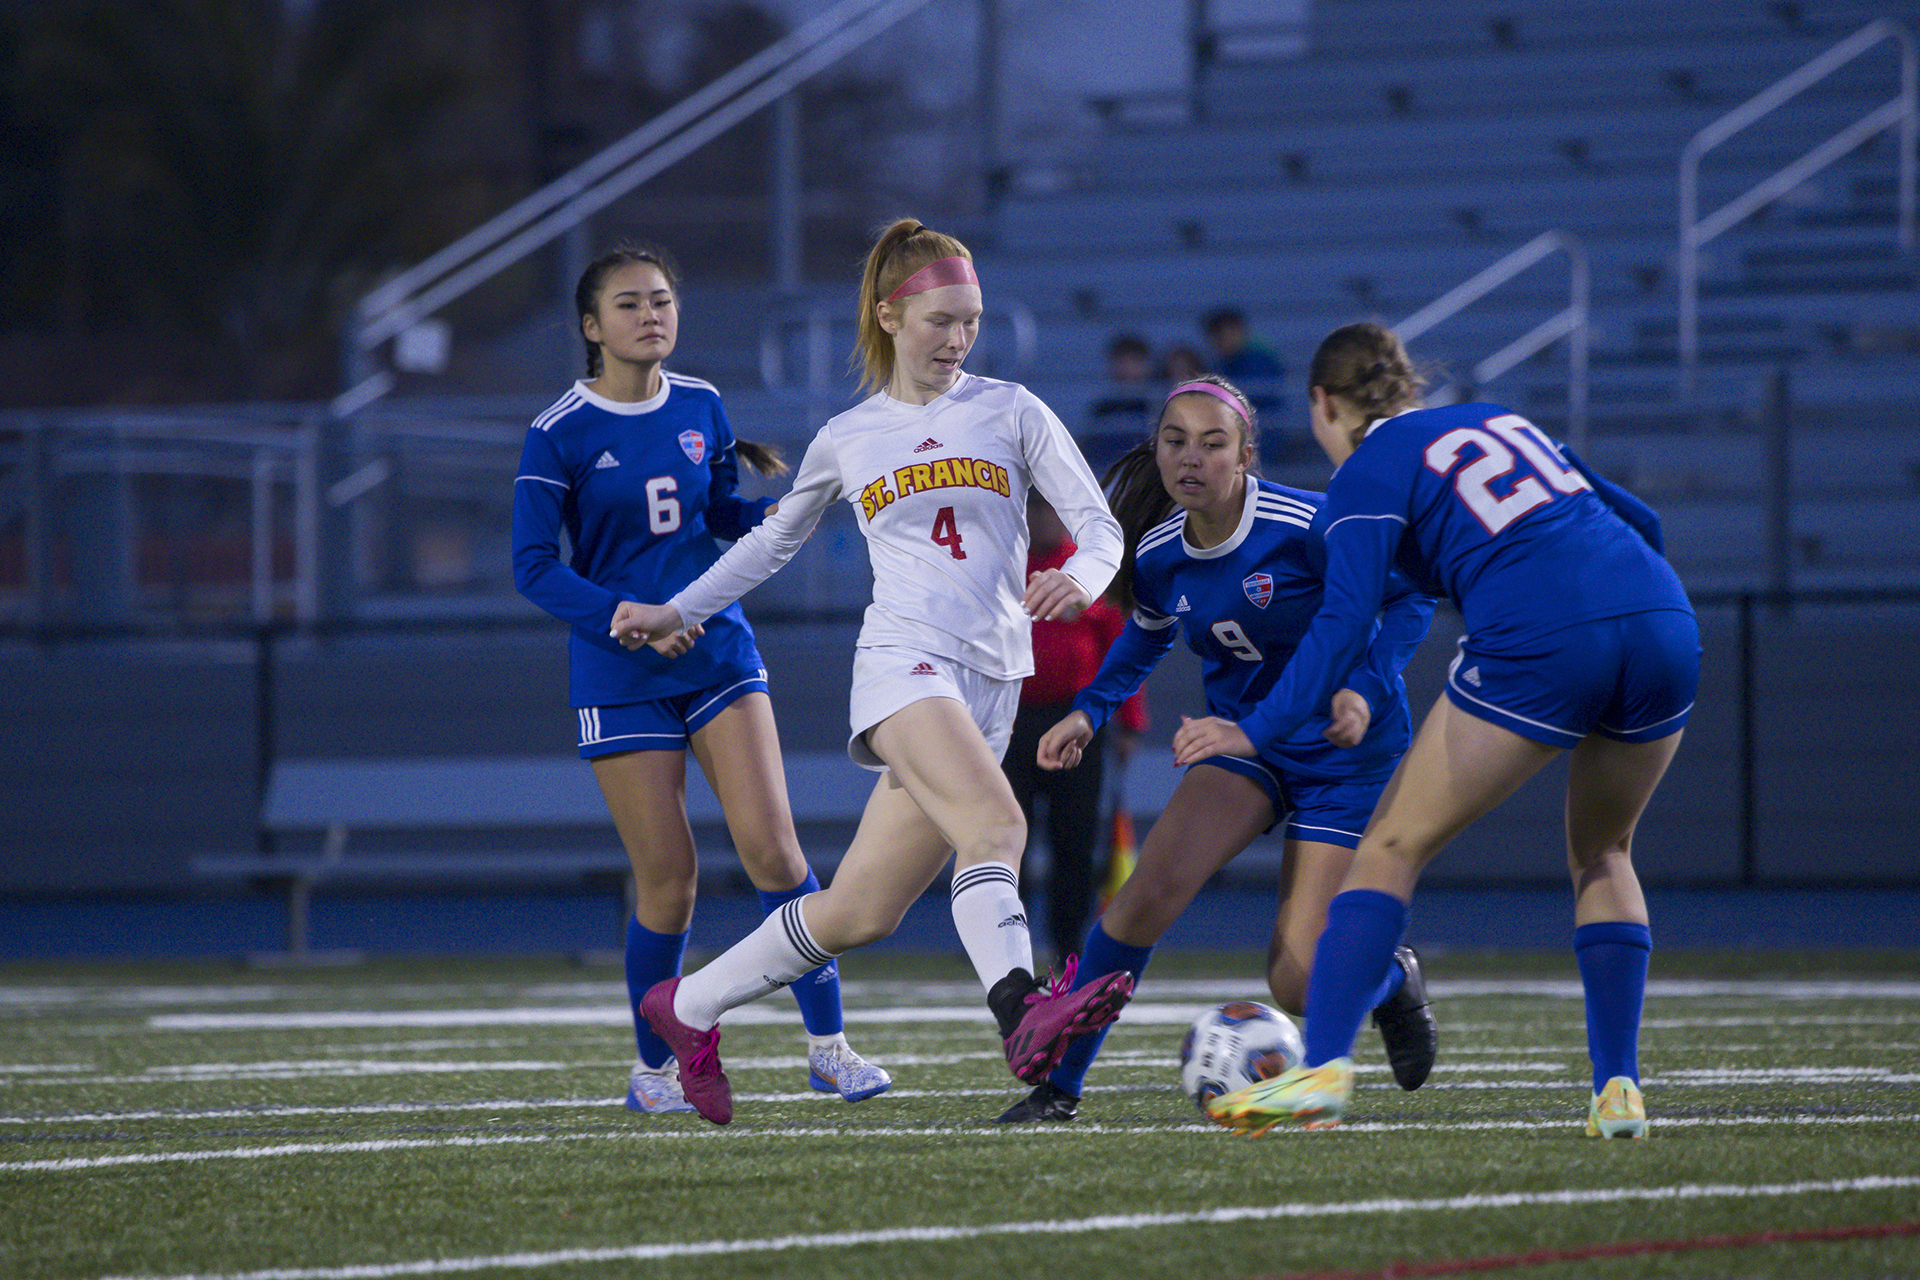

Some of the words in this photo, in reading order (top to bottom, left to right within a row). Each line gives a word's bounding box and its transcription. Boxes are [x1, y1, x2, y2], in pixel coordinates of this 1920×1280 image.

[913, 442, 943, 453] adidas
[1422, 414, 1594, 536] 20
[645, 475, 681, 535] 6
[859, 476, 895, 523] ST.
[894, 458, 1010, 498] FRANCIS
[931, 506, 967, 560] 4
[1210, 619, 1264, 661] 9
